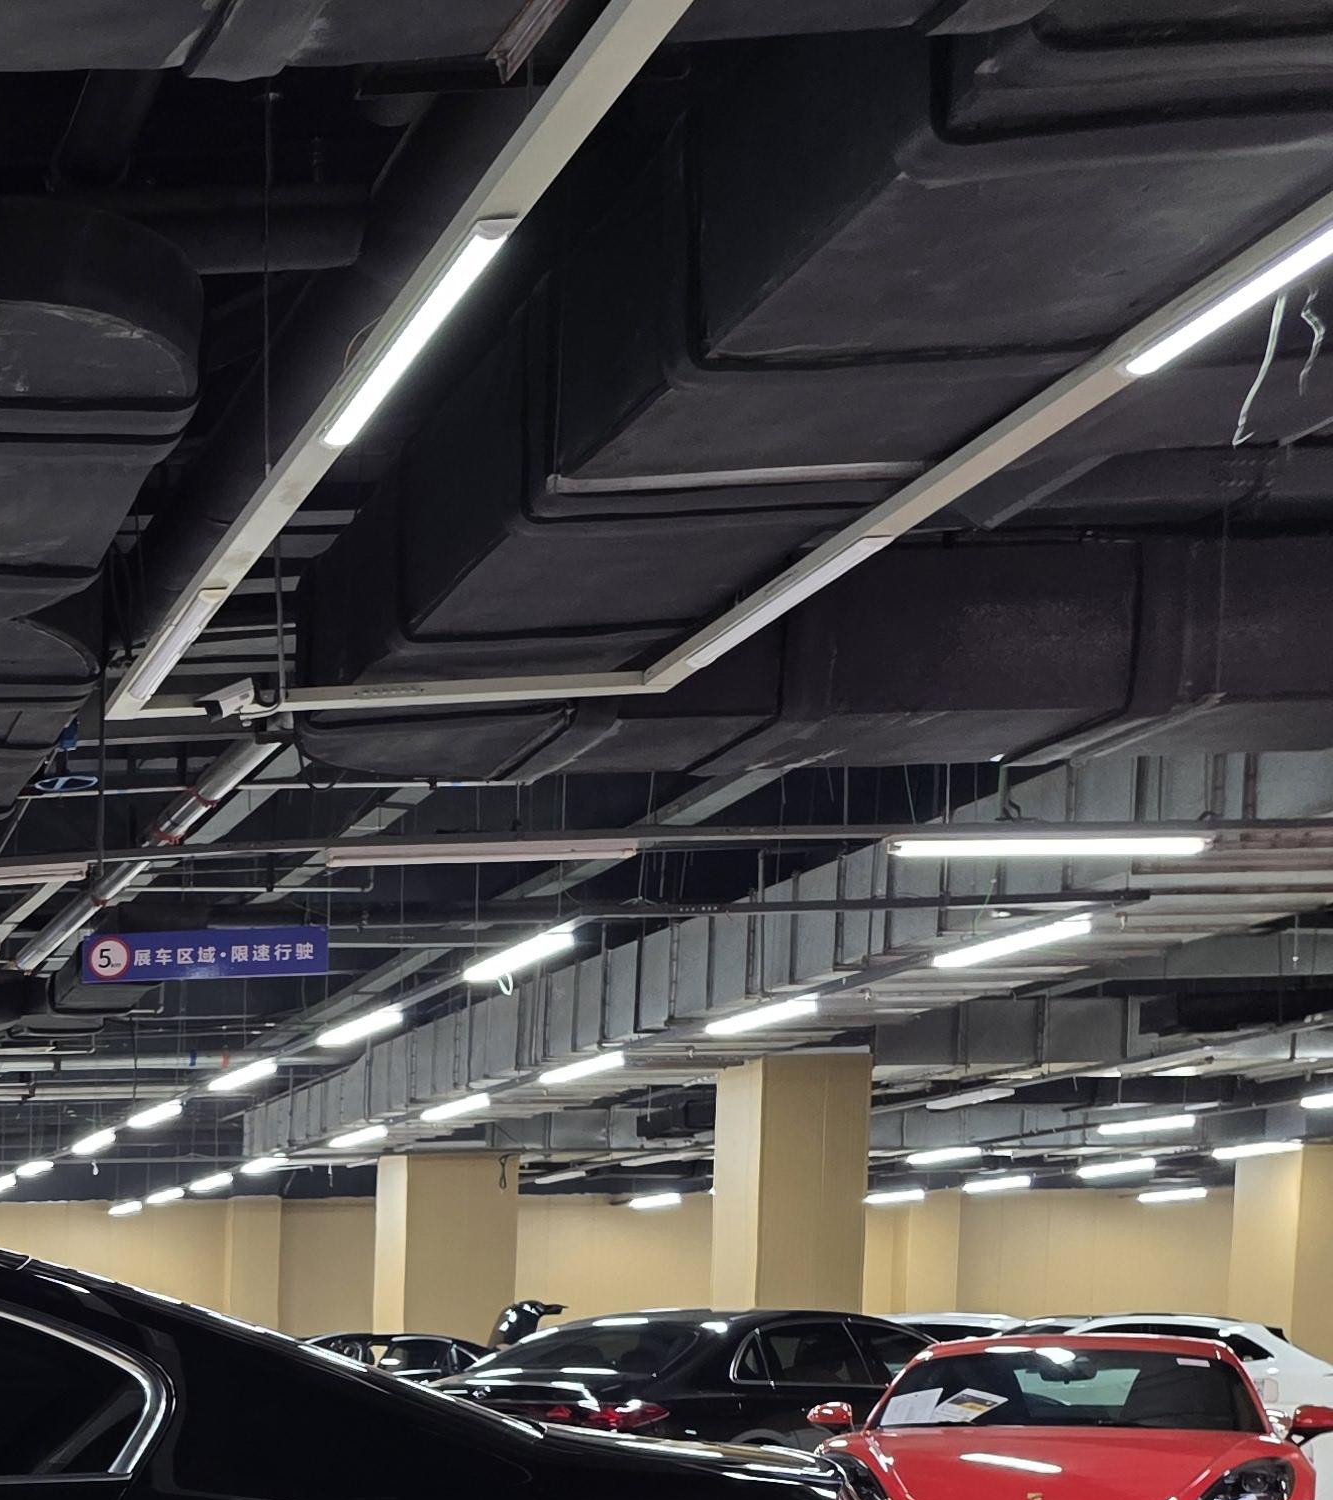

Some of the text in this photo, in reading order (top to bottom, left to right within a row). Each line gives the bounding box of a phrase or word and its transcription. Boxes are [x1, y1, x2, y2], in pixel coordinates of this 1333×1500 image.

[134, 942, 314, 967] 展车区域·限速行驶
